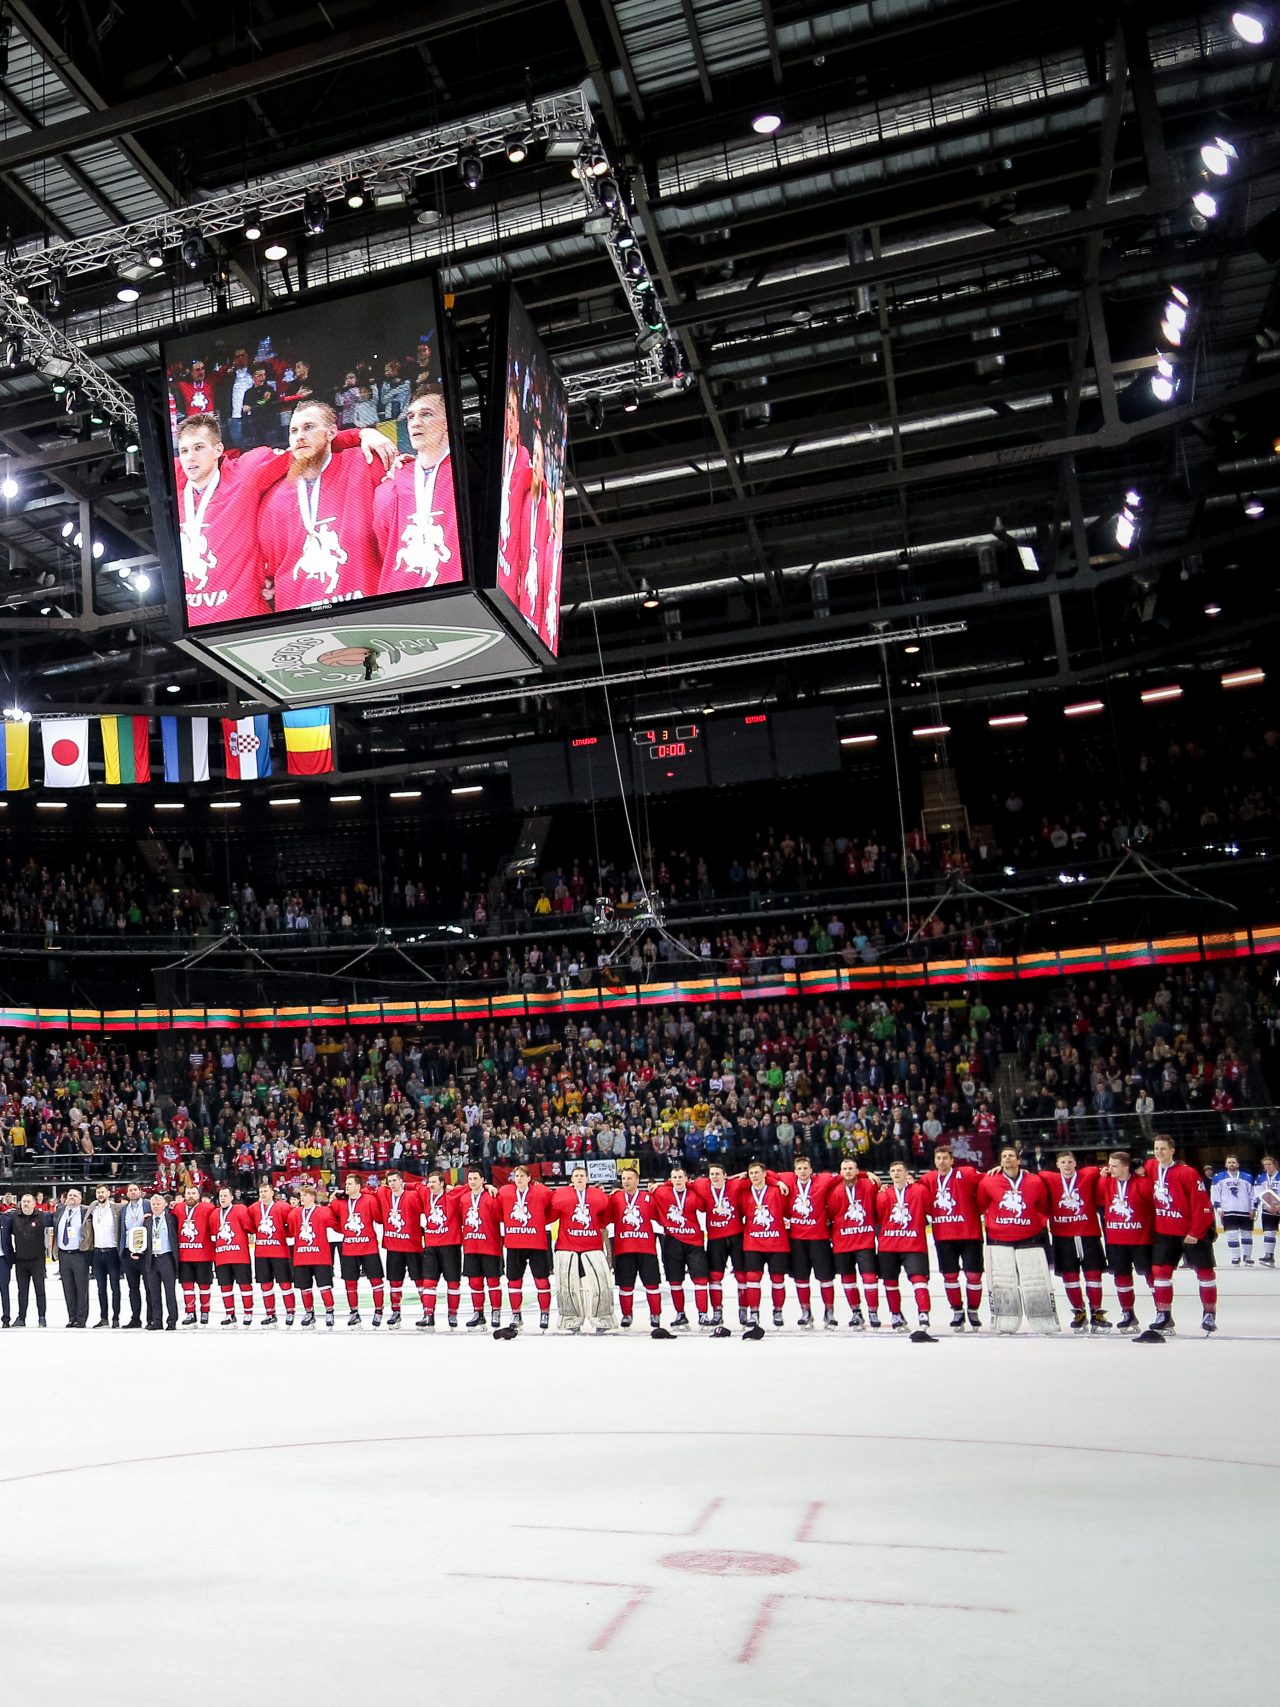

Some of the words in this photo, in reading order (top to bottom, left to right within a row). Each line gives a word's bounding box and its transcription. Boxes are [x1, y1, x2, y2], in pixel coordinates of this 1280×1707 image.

[646, 730, 656, 743] 4
[662, 730, 669, 740] 3
[658, 742, 686, 758] 0:00
[995, 1216, 1032, 1226] LIETUVA
[1106, 1221, 1143, 1230] LIETUVA
[506, 1226, 537, 1235] LIETUVA
[840, 1225, 874, 1236] LIETUVA
[883, 1229, 918, 1238] LIETUVA
